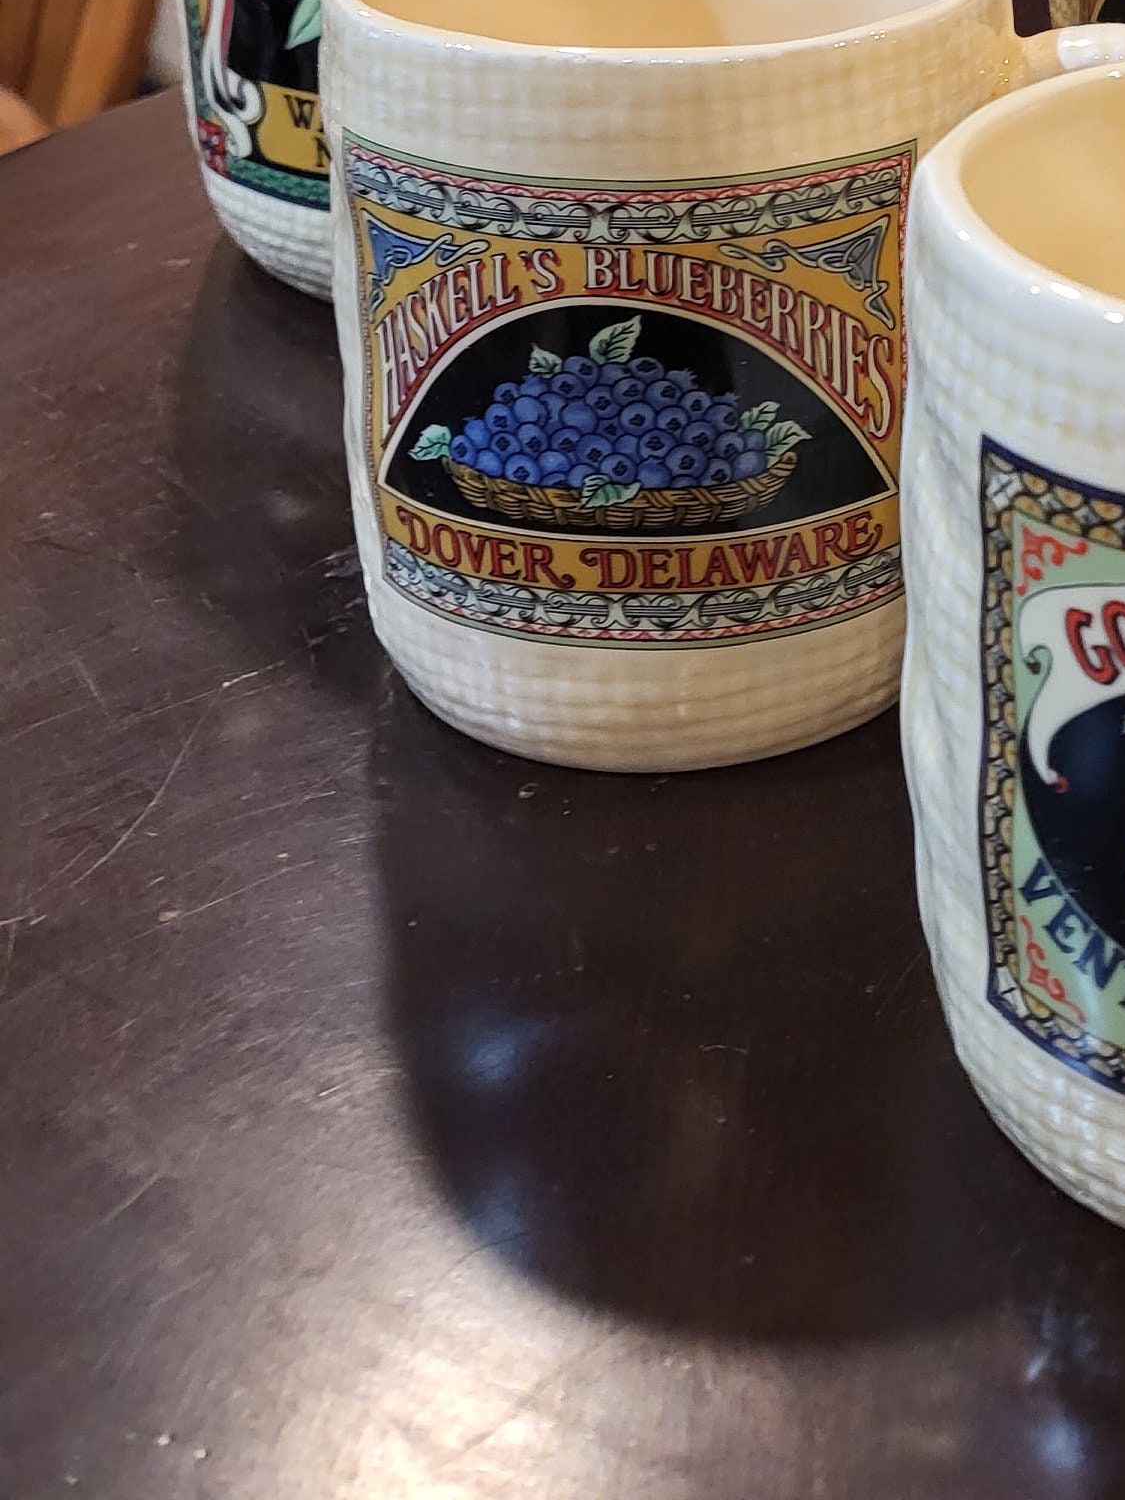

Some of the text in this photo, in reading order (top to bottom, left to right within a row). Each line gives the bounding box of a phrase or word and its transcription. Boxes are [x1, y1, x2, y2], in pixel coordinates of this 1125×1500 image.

[374, 246, 896, 444] HASKELL'S BLUEBERRIES
[396, 505, 884, 590] DOVER DELAWARE
